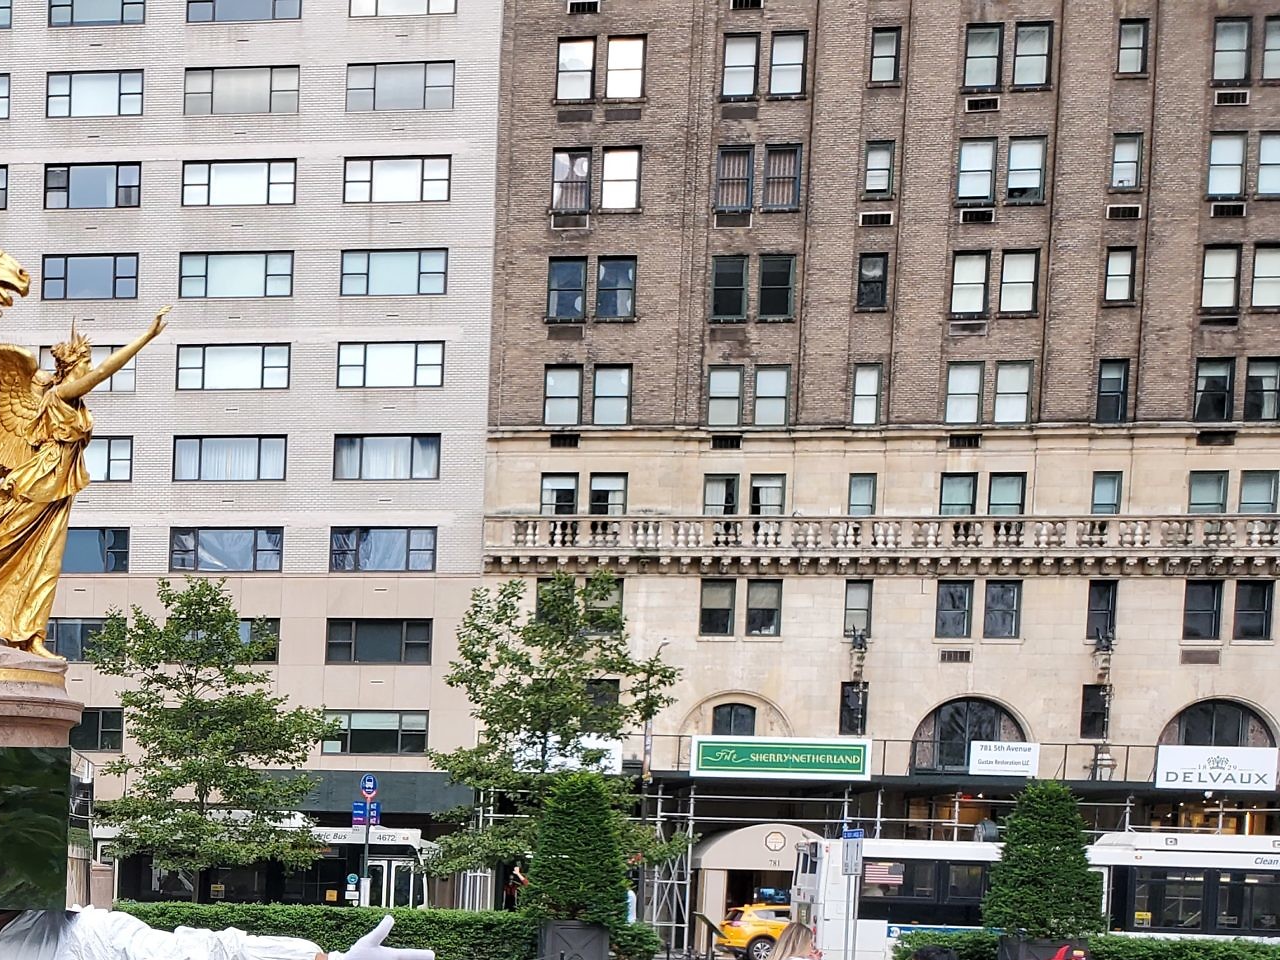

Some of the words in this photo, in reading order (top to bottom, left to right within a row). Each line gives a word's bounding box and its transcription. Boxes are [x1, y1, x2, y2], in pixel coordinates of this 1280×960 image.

[993, 744, 1005, 752] 5th
[1006, 745, 1032, 753] Avenue
[1165, 771, 1268, 785] DELVAUX
[332, 832, 347, 840] Bus
[376, 834, 396, 842] 4672
[1253, 856, 1279, 866] Clean
